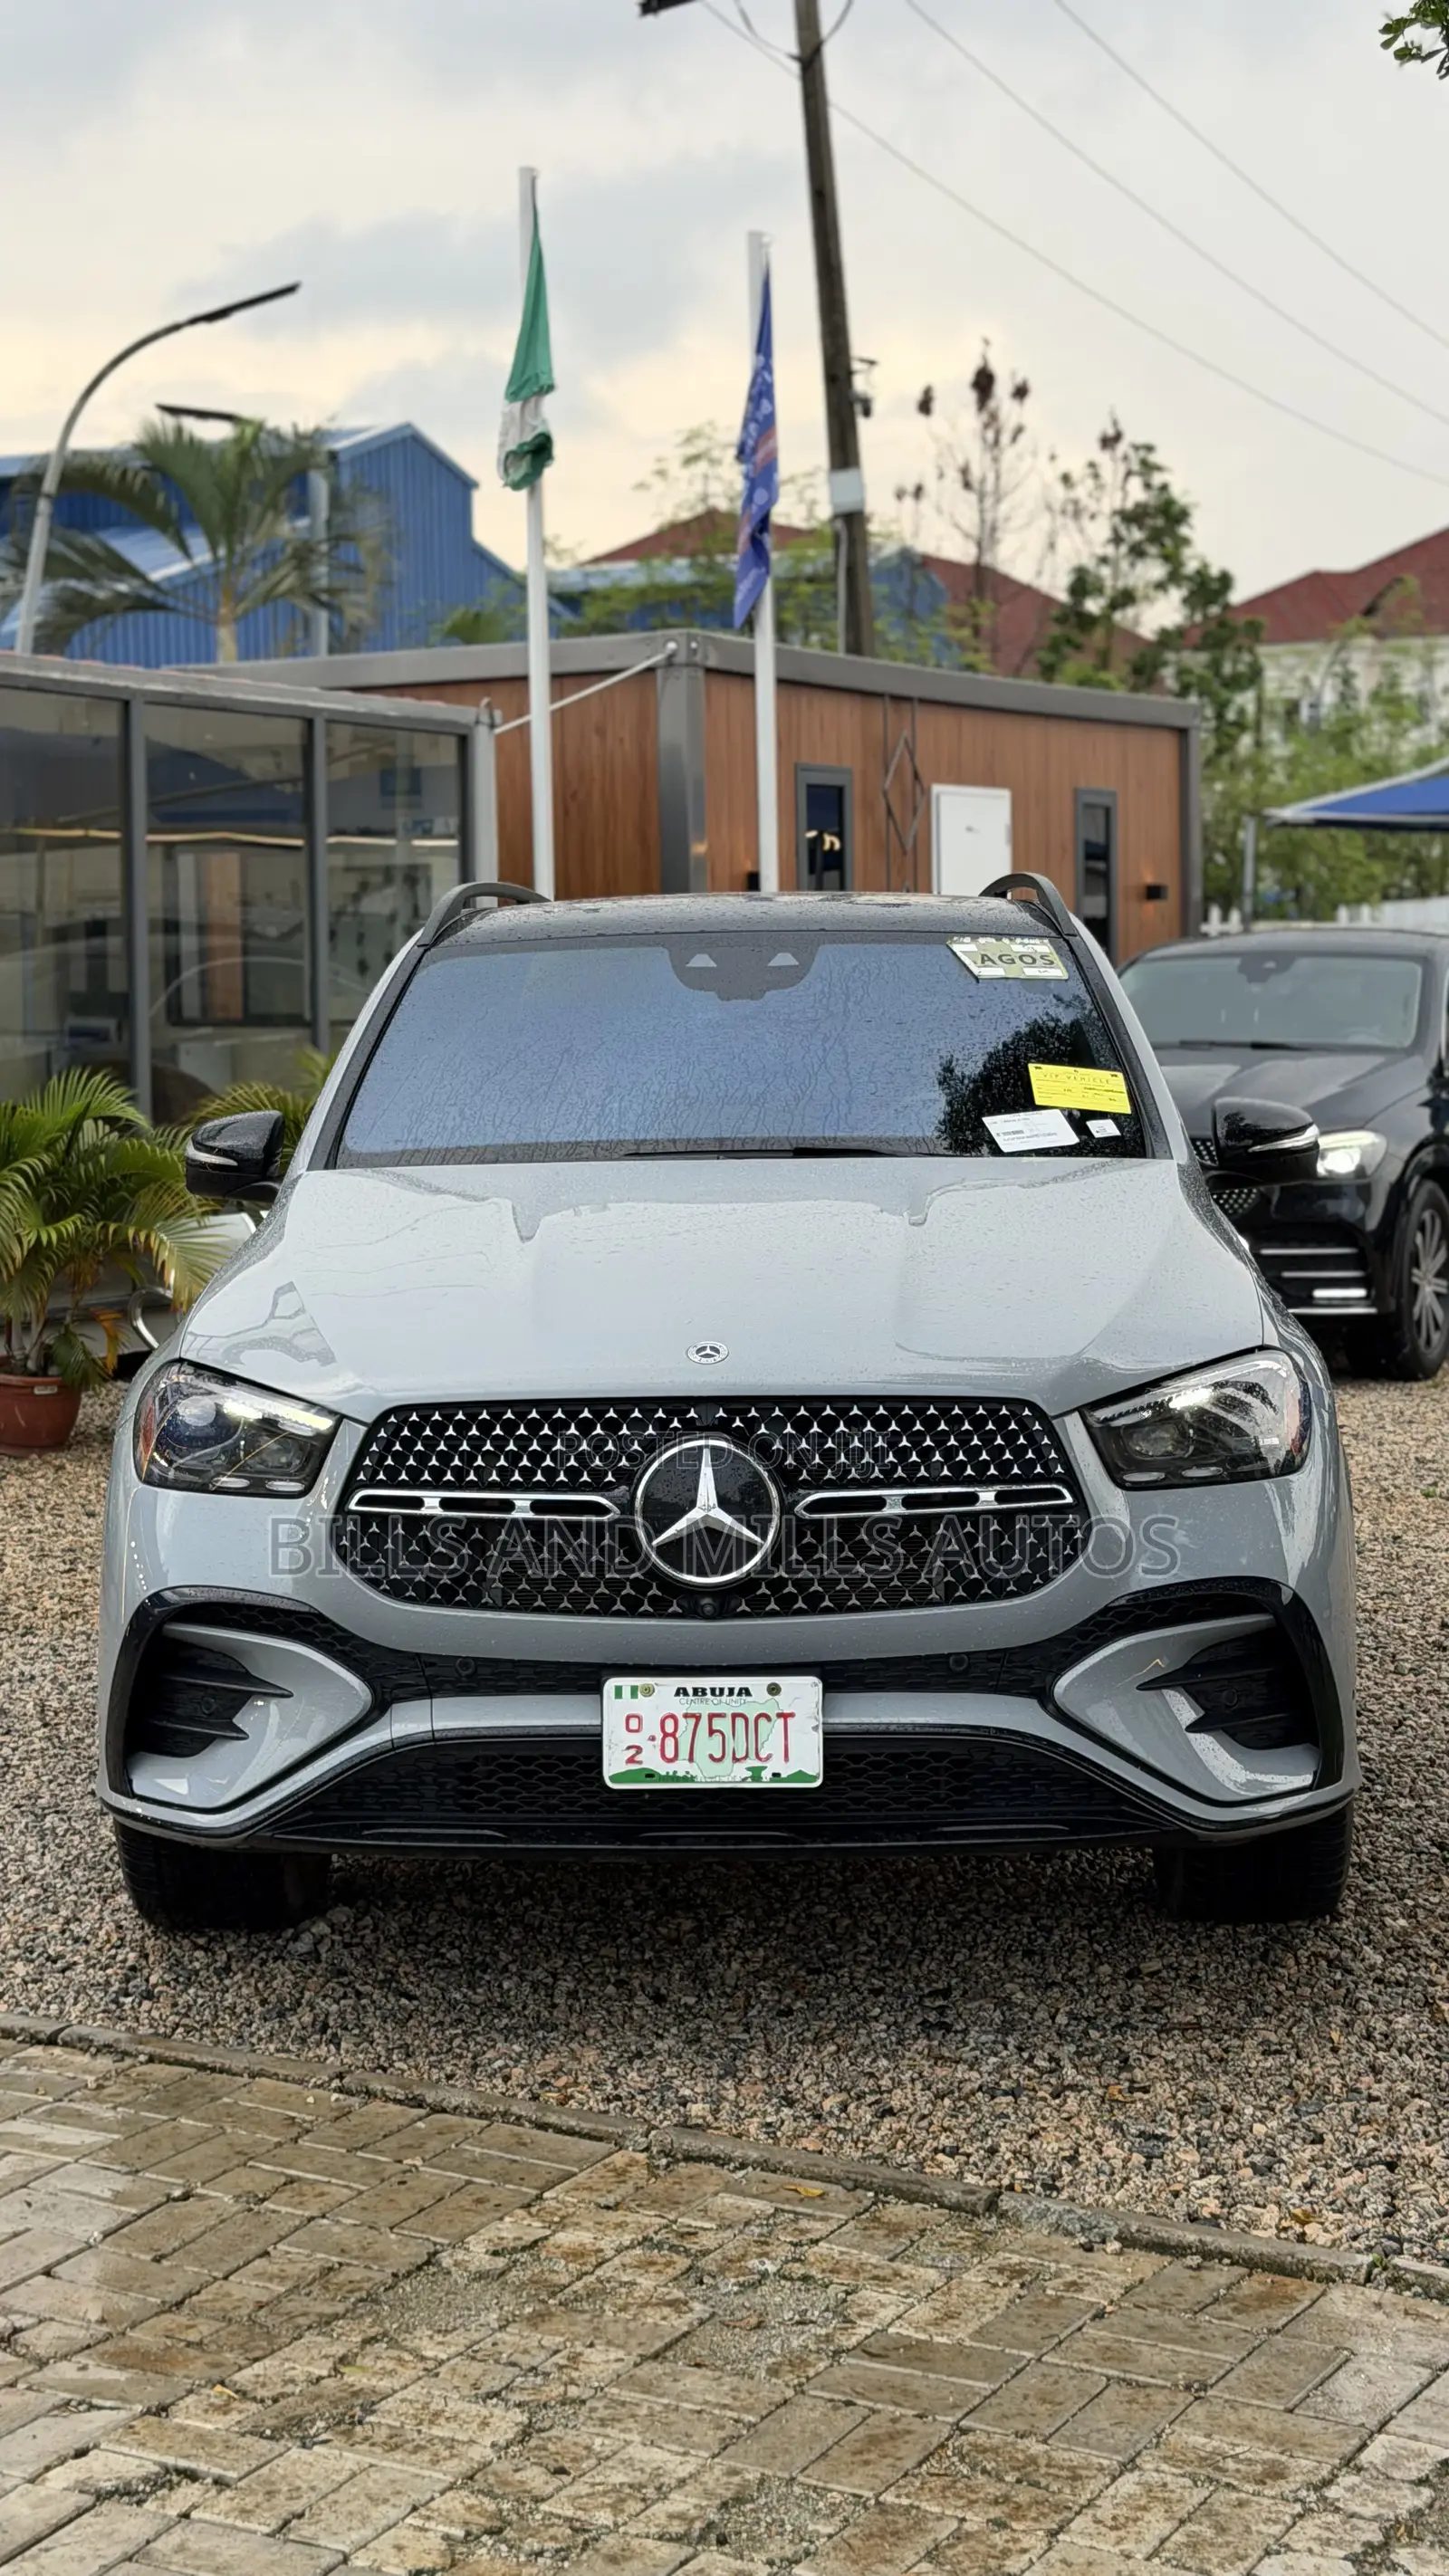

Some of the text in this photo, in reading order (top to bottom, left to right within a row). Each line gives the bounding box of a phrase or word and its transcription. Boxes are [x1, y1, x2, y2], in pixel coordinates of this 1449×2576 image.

[673, 1686, 753, 1698] ABUJA
[678, 1698, 747, 1706] CENTRE OF UNITY
